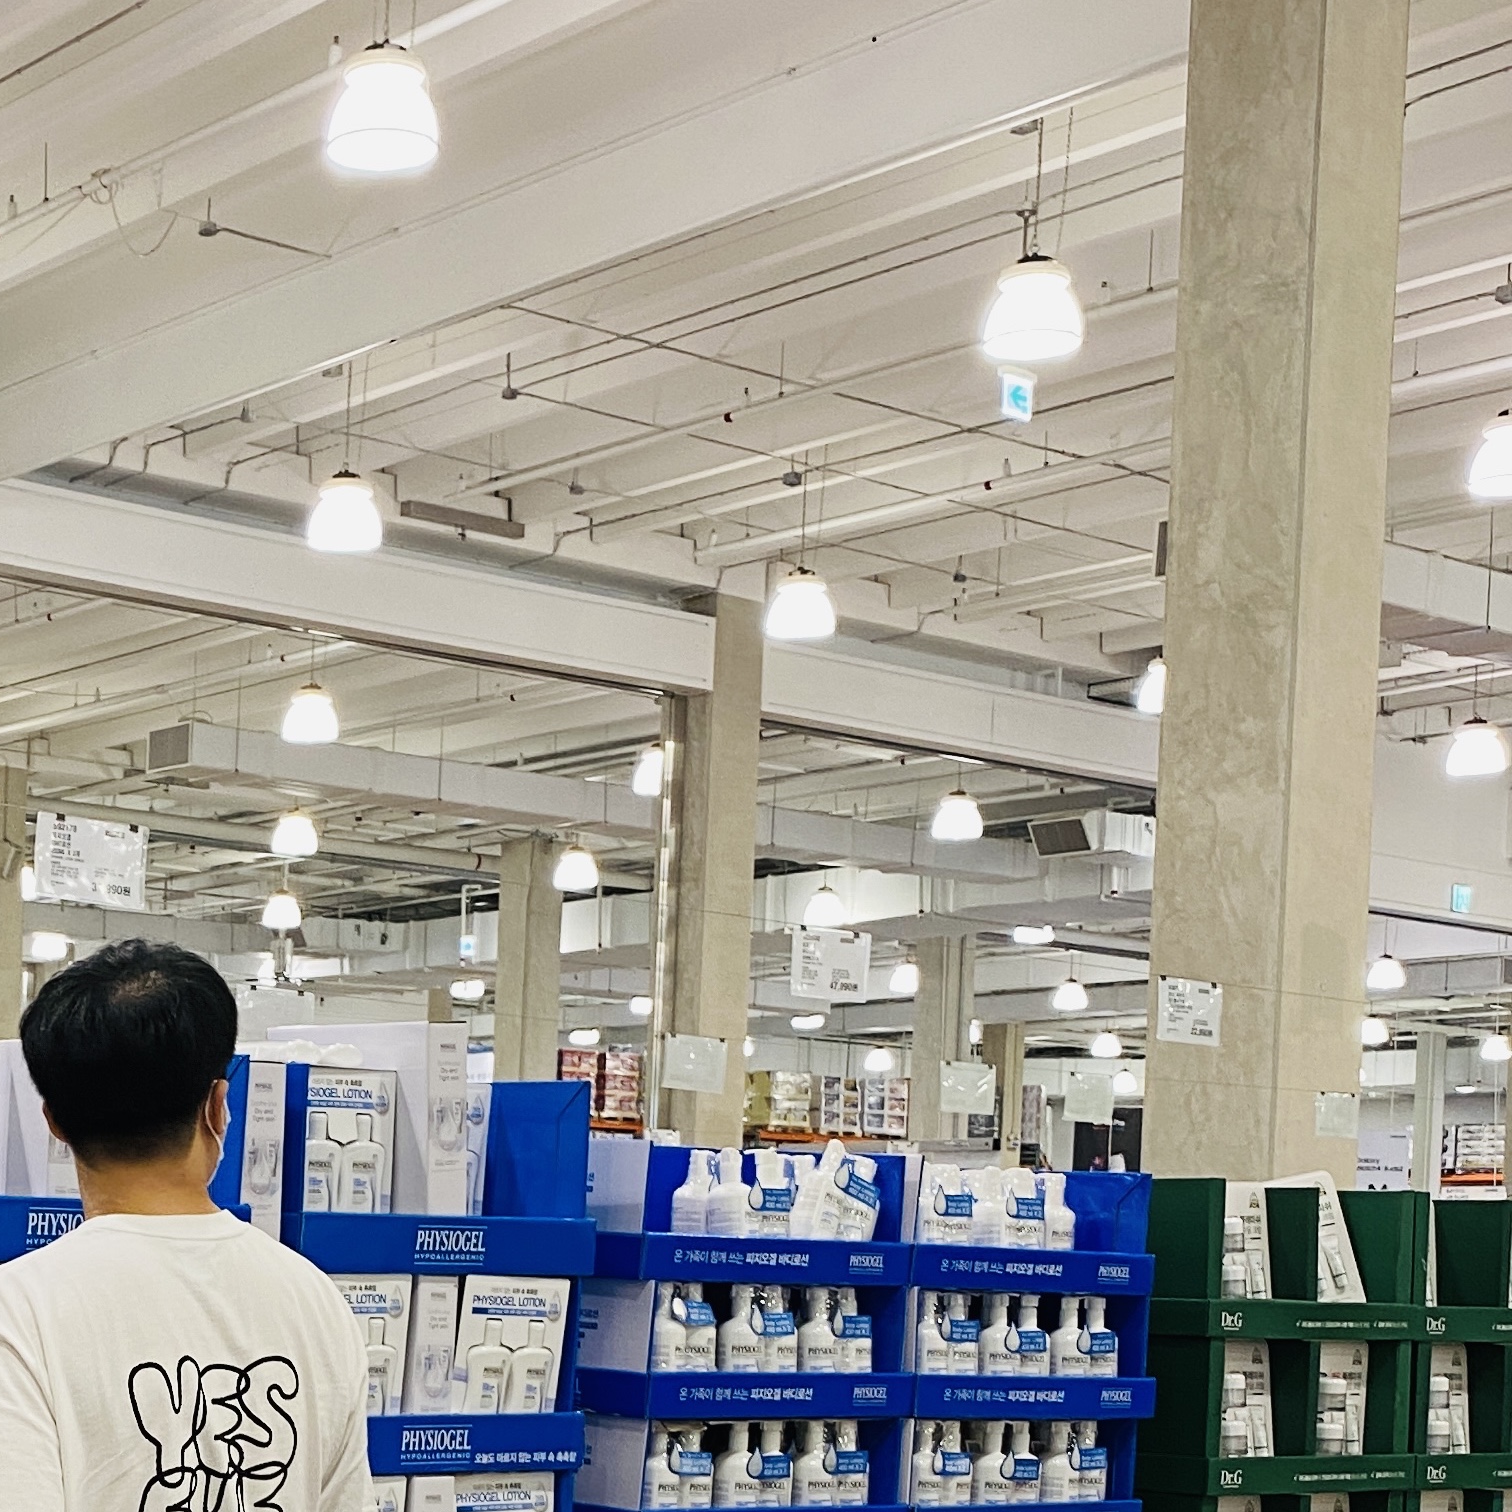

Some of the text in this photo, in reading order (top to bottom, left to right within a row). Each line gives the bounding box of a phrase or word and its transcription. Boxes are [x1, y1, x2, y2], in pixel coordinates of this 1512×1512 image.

[27, 1212, 85, 1237] PHYSIO
[415, 1230, 486, 1253] PHYSIOGEL
[1098, 1266, 1130, 1279] PHYSIOGEL
[472, 1294, 546, 1308] PHYSIOGEL LOTION
[1221, 1312, 1242, 1327] Dr.G
[1426, 1317, 1446, 1331] Dr.G
[129, 1355, 299, 1488] YES
[401, 1429, 472, 1451] PHYSIOGEL
[1220, 1471, 1242, 1485] Dr.G
[1427, 1466, 1446, 1480] Dr.G
[455, 1490, 531, 1504] PHYSIOGEL LOTION
